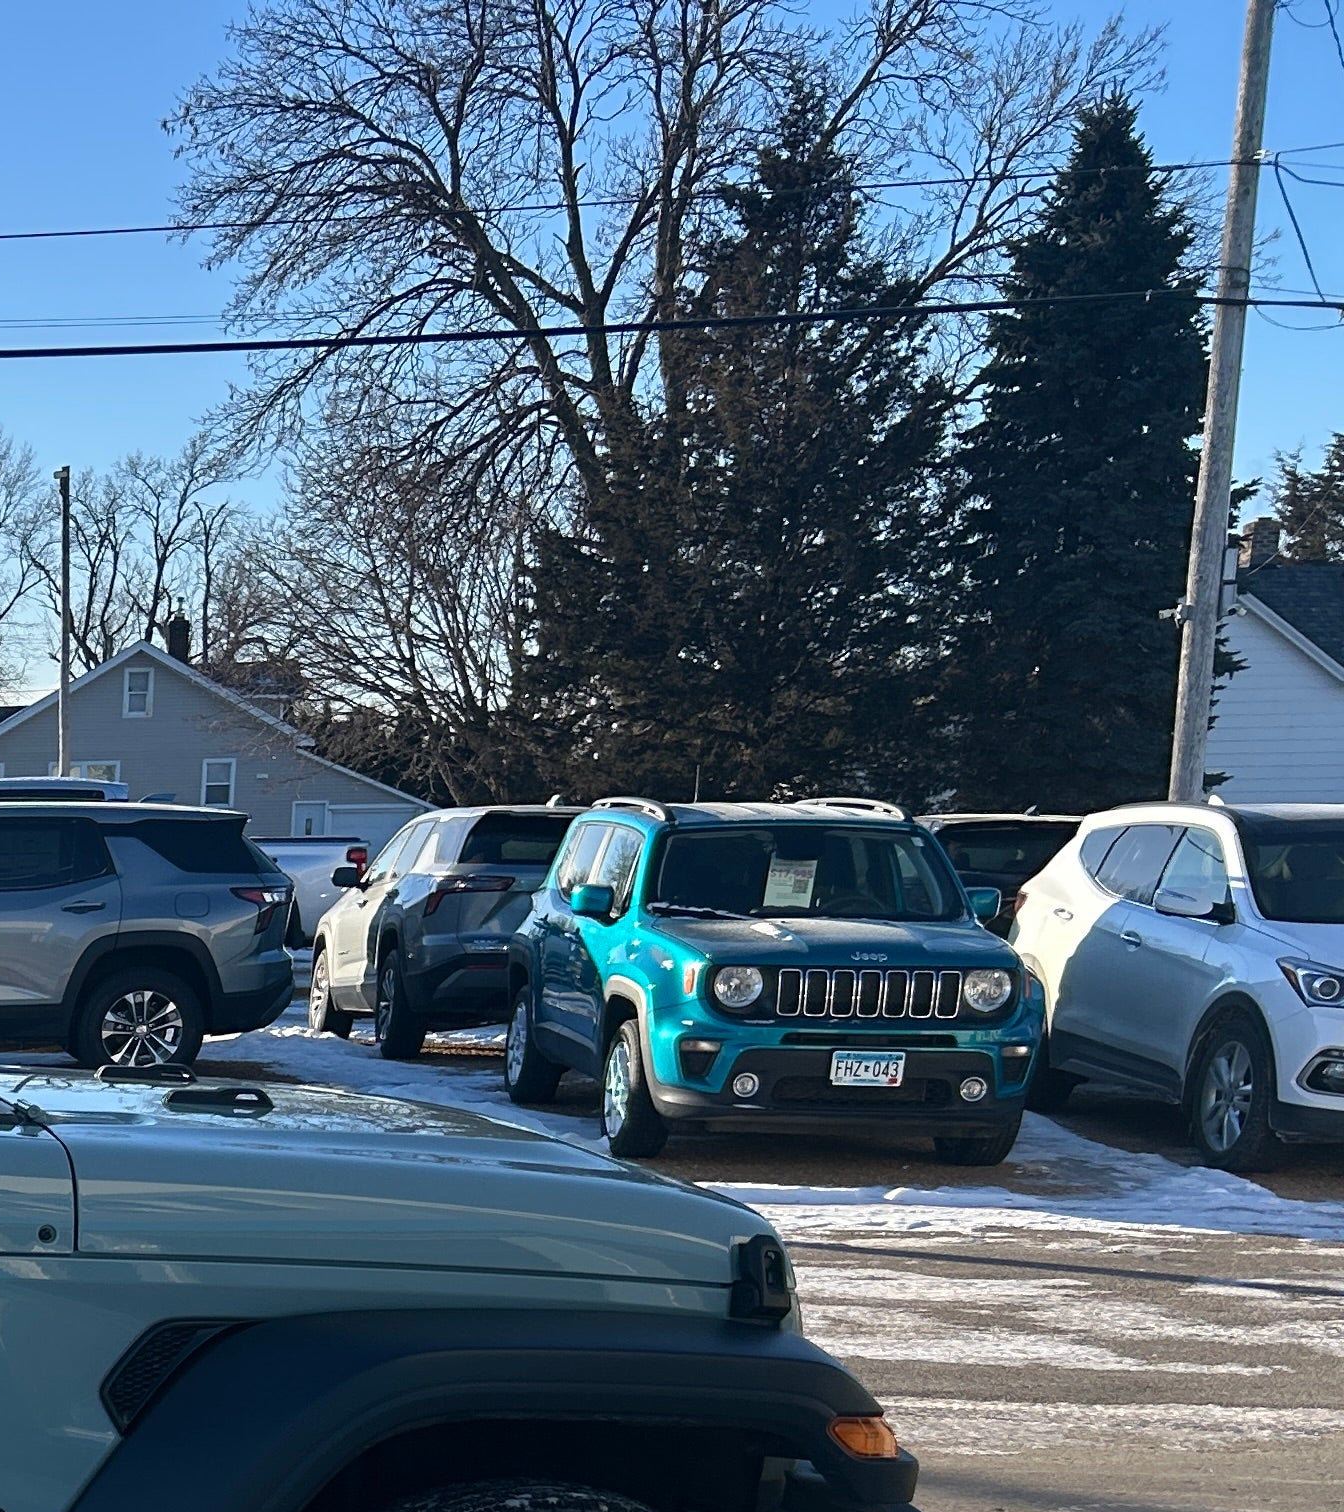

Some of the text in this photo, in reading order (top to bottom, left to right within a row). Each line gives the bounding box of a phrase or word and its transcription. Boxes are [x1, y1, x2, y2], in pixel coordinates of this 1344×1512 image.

[850, 951, 888, 962] Jeep
[835, 1060, 899, 1077] FHZ 043
